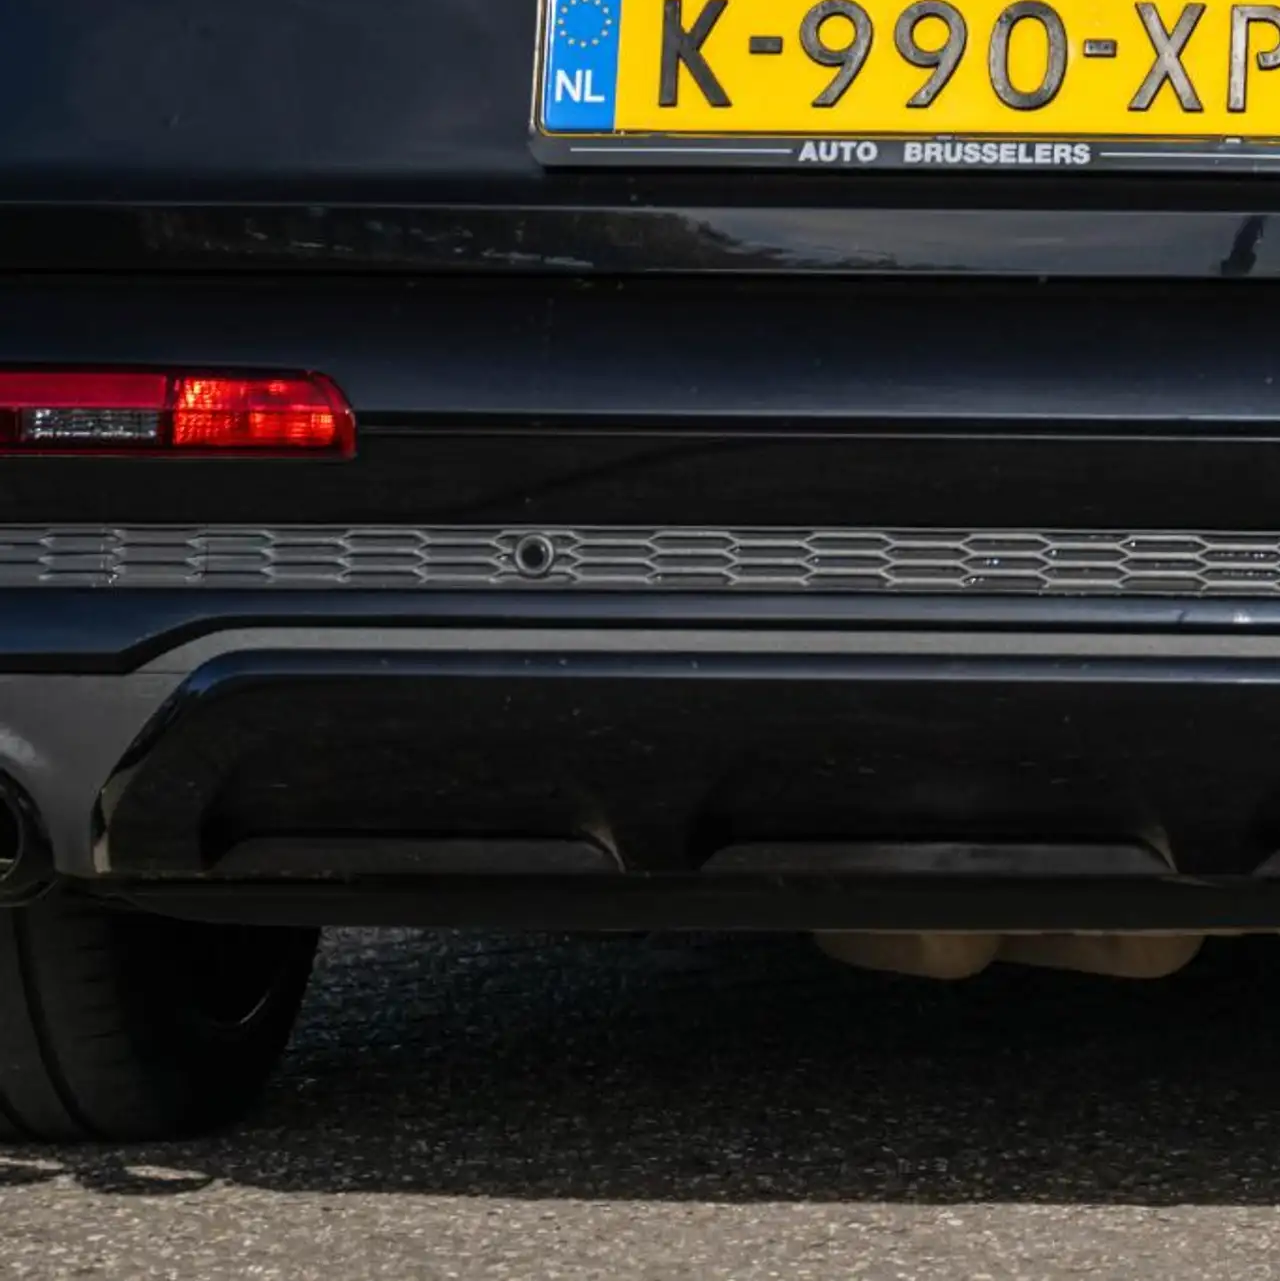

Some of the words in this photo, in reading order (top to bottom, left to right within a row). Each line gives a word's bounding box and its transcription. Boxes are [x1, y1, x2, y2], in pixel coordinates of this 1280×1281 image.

[554, 69, 605, 103] NL
[798, 140, 879, 163] AUTO
[903, 142, 1091, 165] BRUSSELERS
